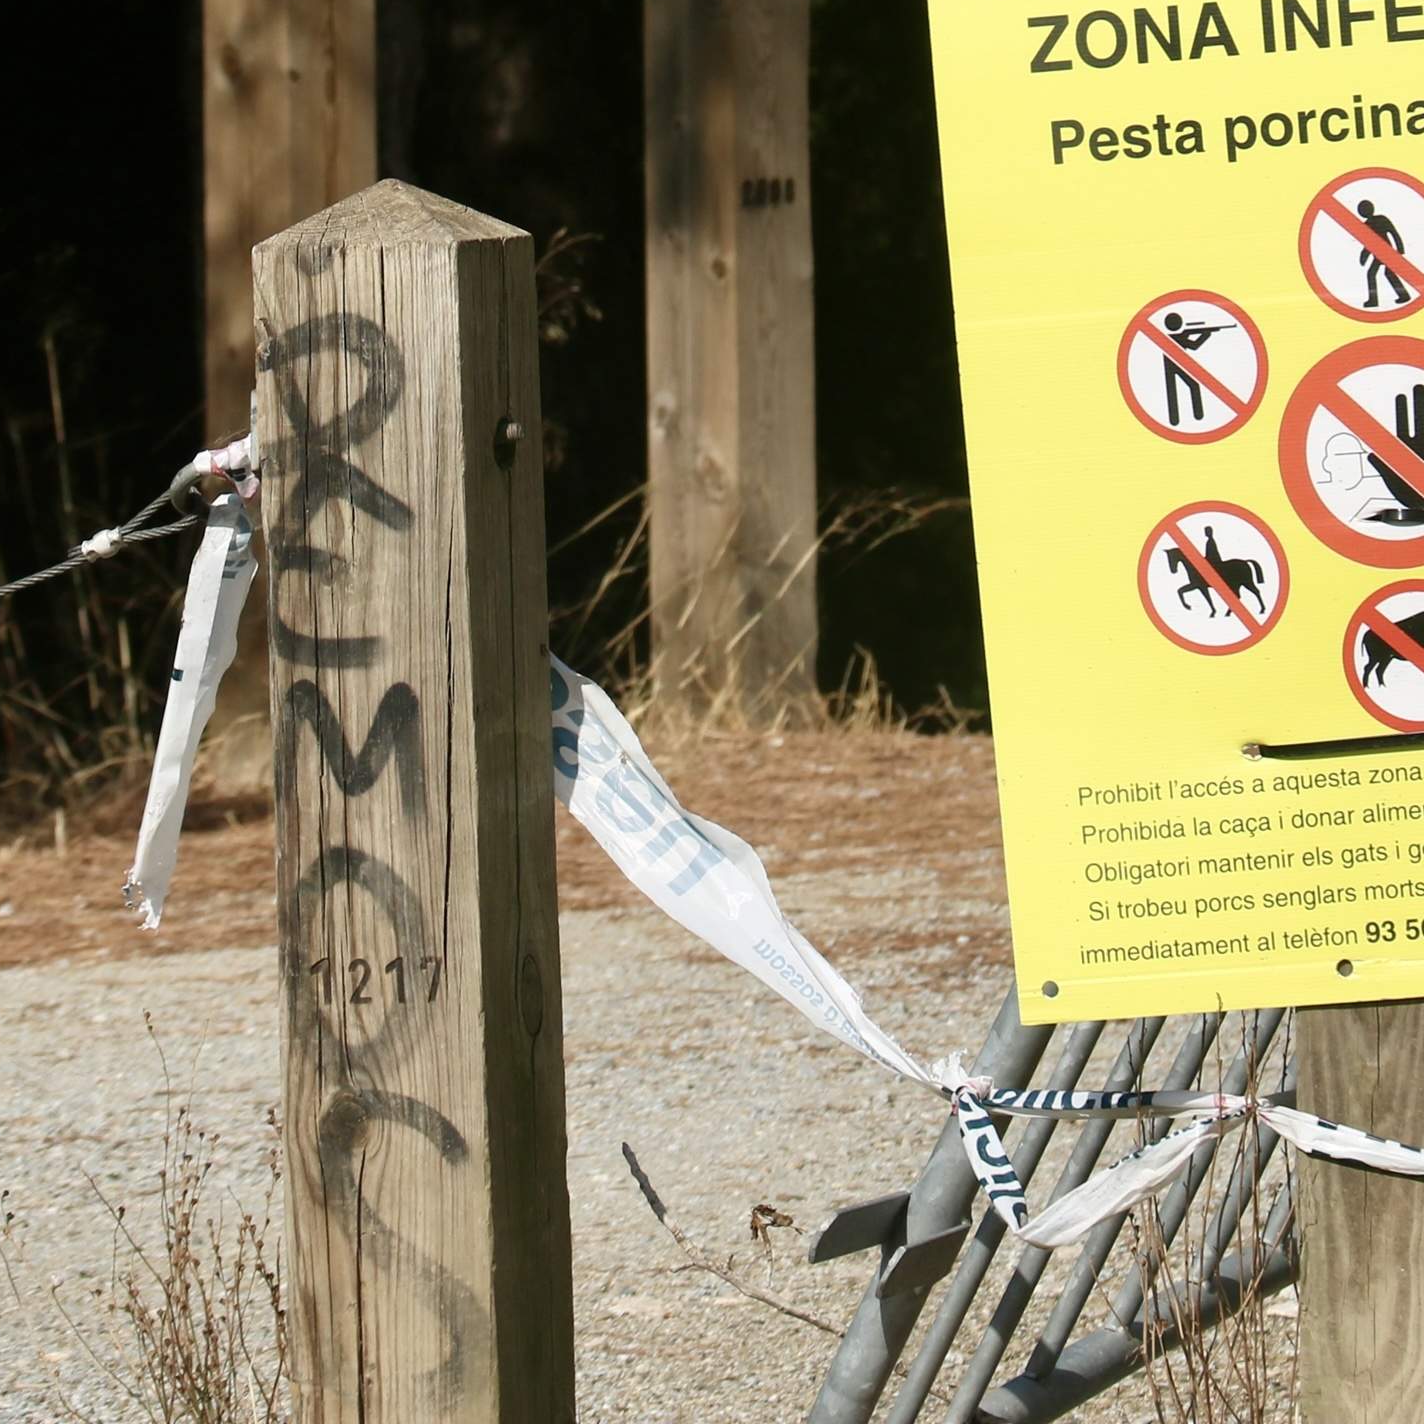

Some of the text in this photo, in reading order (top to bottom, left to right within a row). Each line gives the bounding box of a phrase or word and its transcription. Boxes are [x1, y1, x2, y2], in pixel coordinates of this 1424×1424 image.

[1028, 2, 1239, 73] ZONA
[1051, 115, 1205, 164] Pesta
[1079, 783, 1161, 806] Prohibit
[1169, 776, 1244, 798] l'accés
[1253, 778, 1265, 793] a
[1273, 769, 1360, 794] aquesta
[1369, 766, 1422, 784] zona
[1082, 820, 1185, 844] Prohibida
[1194, 818, 1211, 835] la
[1220, 817, 1271, 837] caça
[1279, 811, 1283, 829] i
[1292, 809, 1354, 828] donar
[1085, 857, 1190, 884] Obligatori
[1199, 849, 1294, 874] mantenir
[1302, 847, 1333, 866] els
[1341, 844, 1388, 868] gats
[1396, 841, 1400, 859] i
[1089, 902, 1109, 921] Si
[1117, 898, 1186, 918] trobeu
[1195, 895, 1255, 918] porcs
[1263, 885, 1356, 910] senglars
[1082, 936, 1249, 963] immediatament
[1258, 932, 1275, 951] al
[1283, 927, 1357, 949] telèfon
[1366, 921, 1396, 943] 93
[310, 956, 442, 1005] 1217
